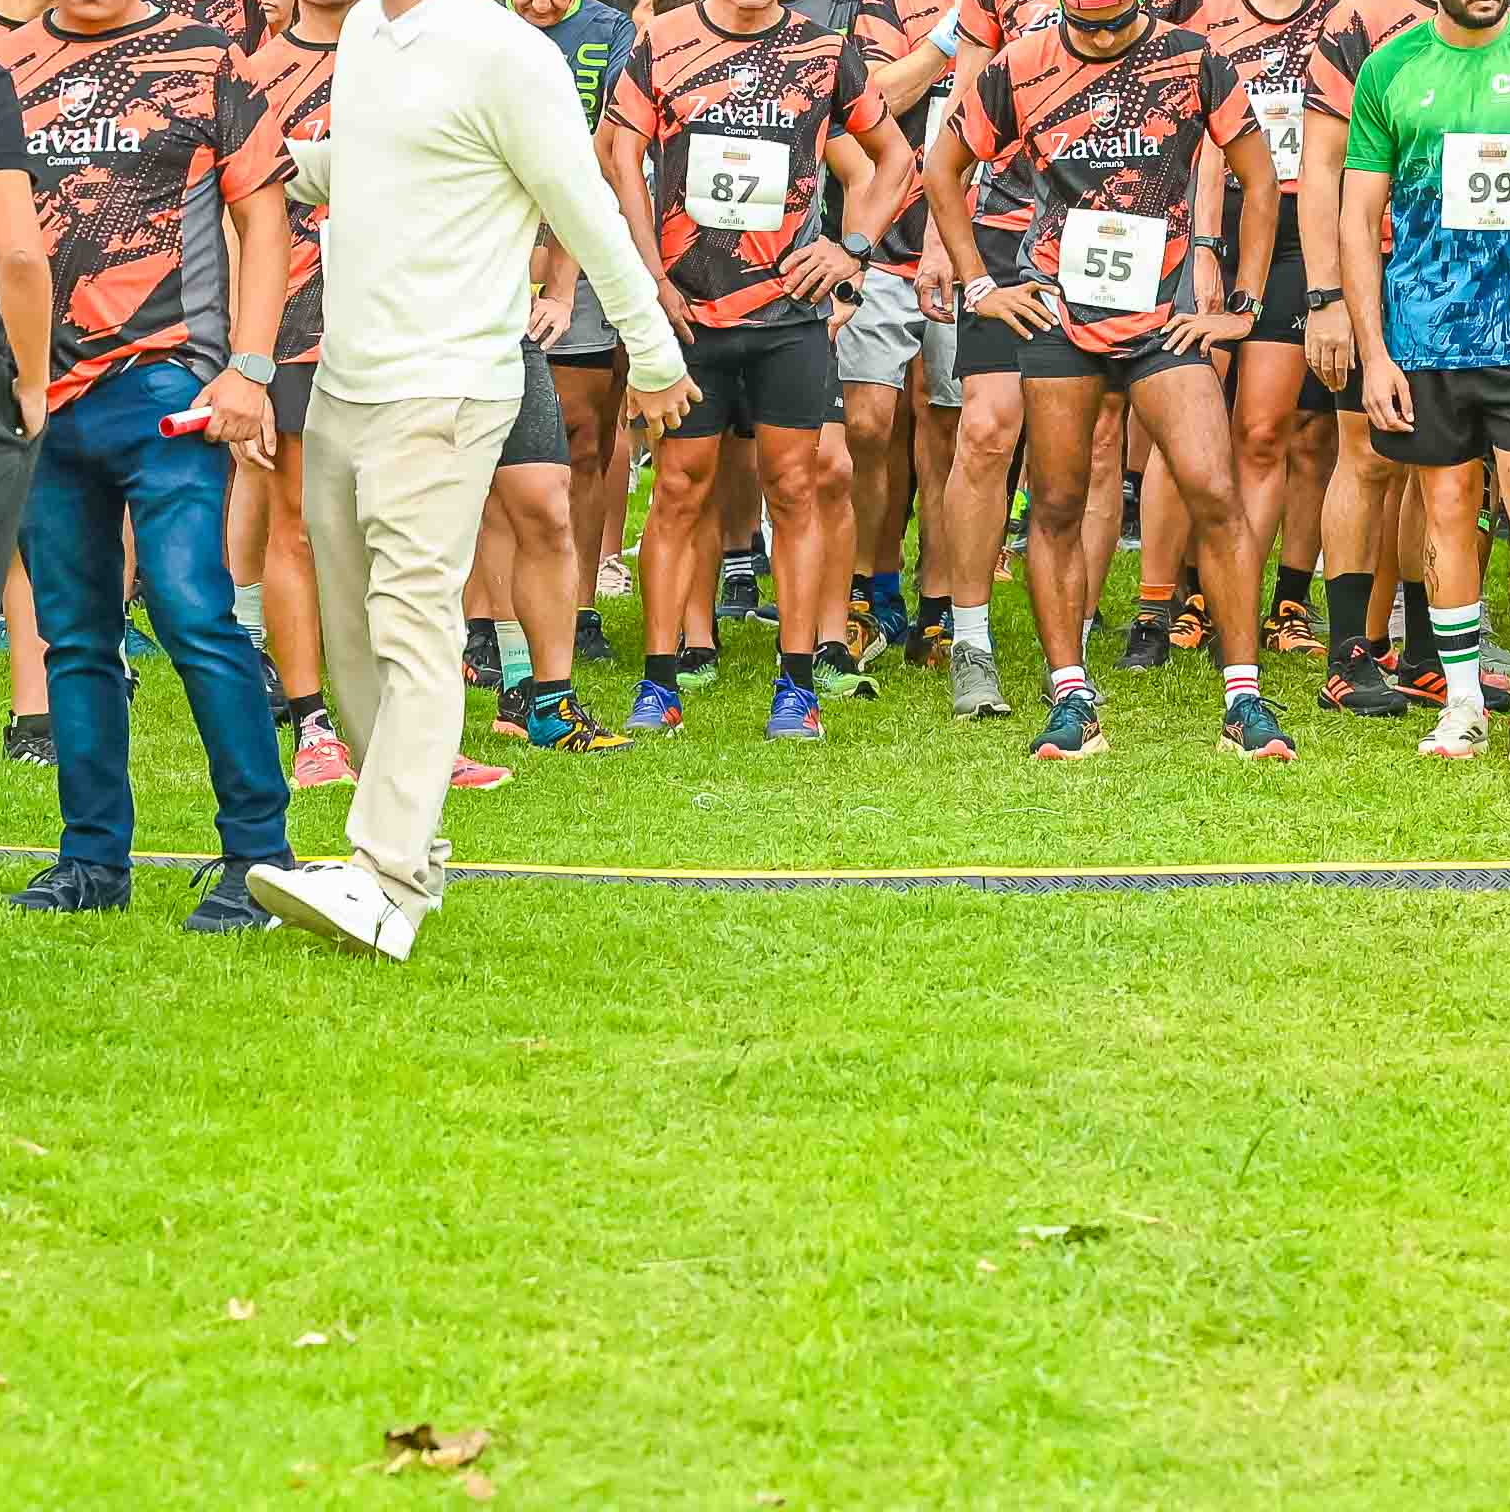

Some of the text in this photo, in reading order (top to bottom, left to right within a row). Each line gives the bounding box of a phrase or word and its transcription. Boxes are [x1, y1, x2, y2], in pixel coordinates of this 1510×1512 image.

[687, 95, 796, 129] Zavalla
[25, 116, 142, 156] avalla
[1049, 126, 1161, 160] Zavalla
[46, 155, 91, 167] Comuna
[1089, 159, 1125, 169] Comuna
[710, 172, 761, 204] 87
[1083, 247, 1134, 282] 55
